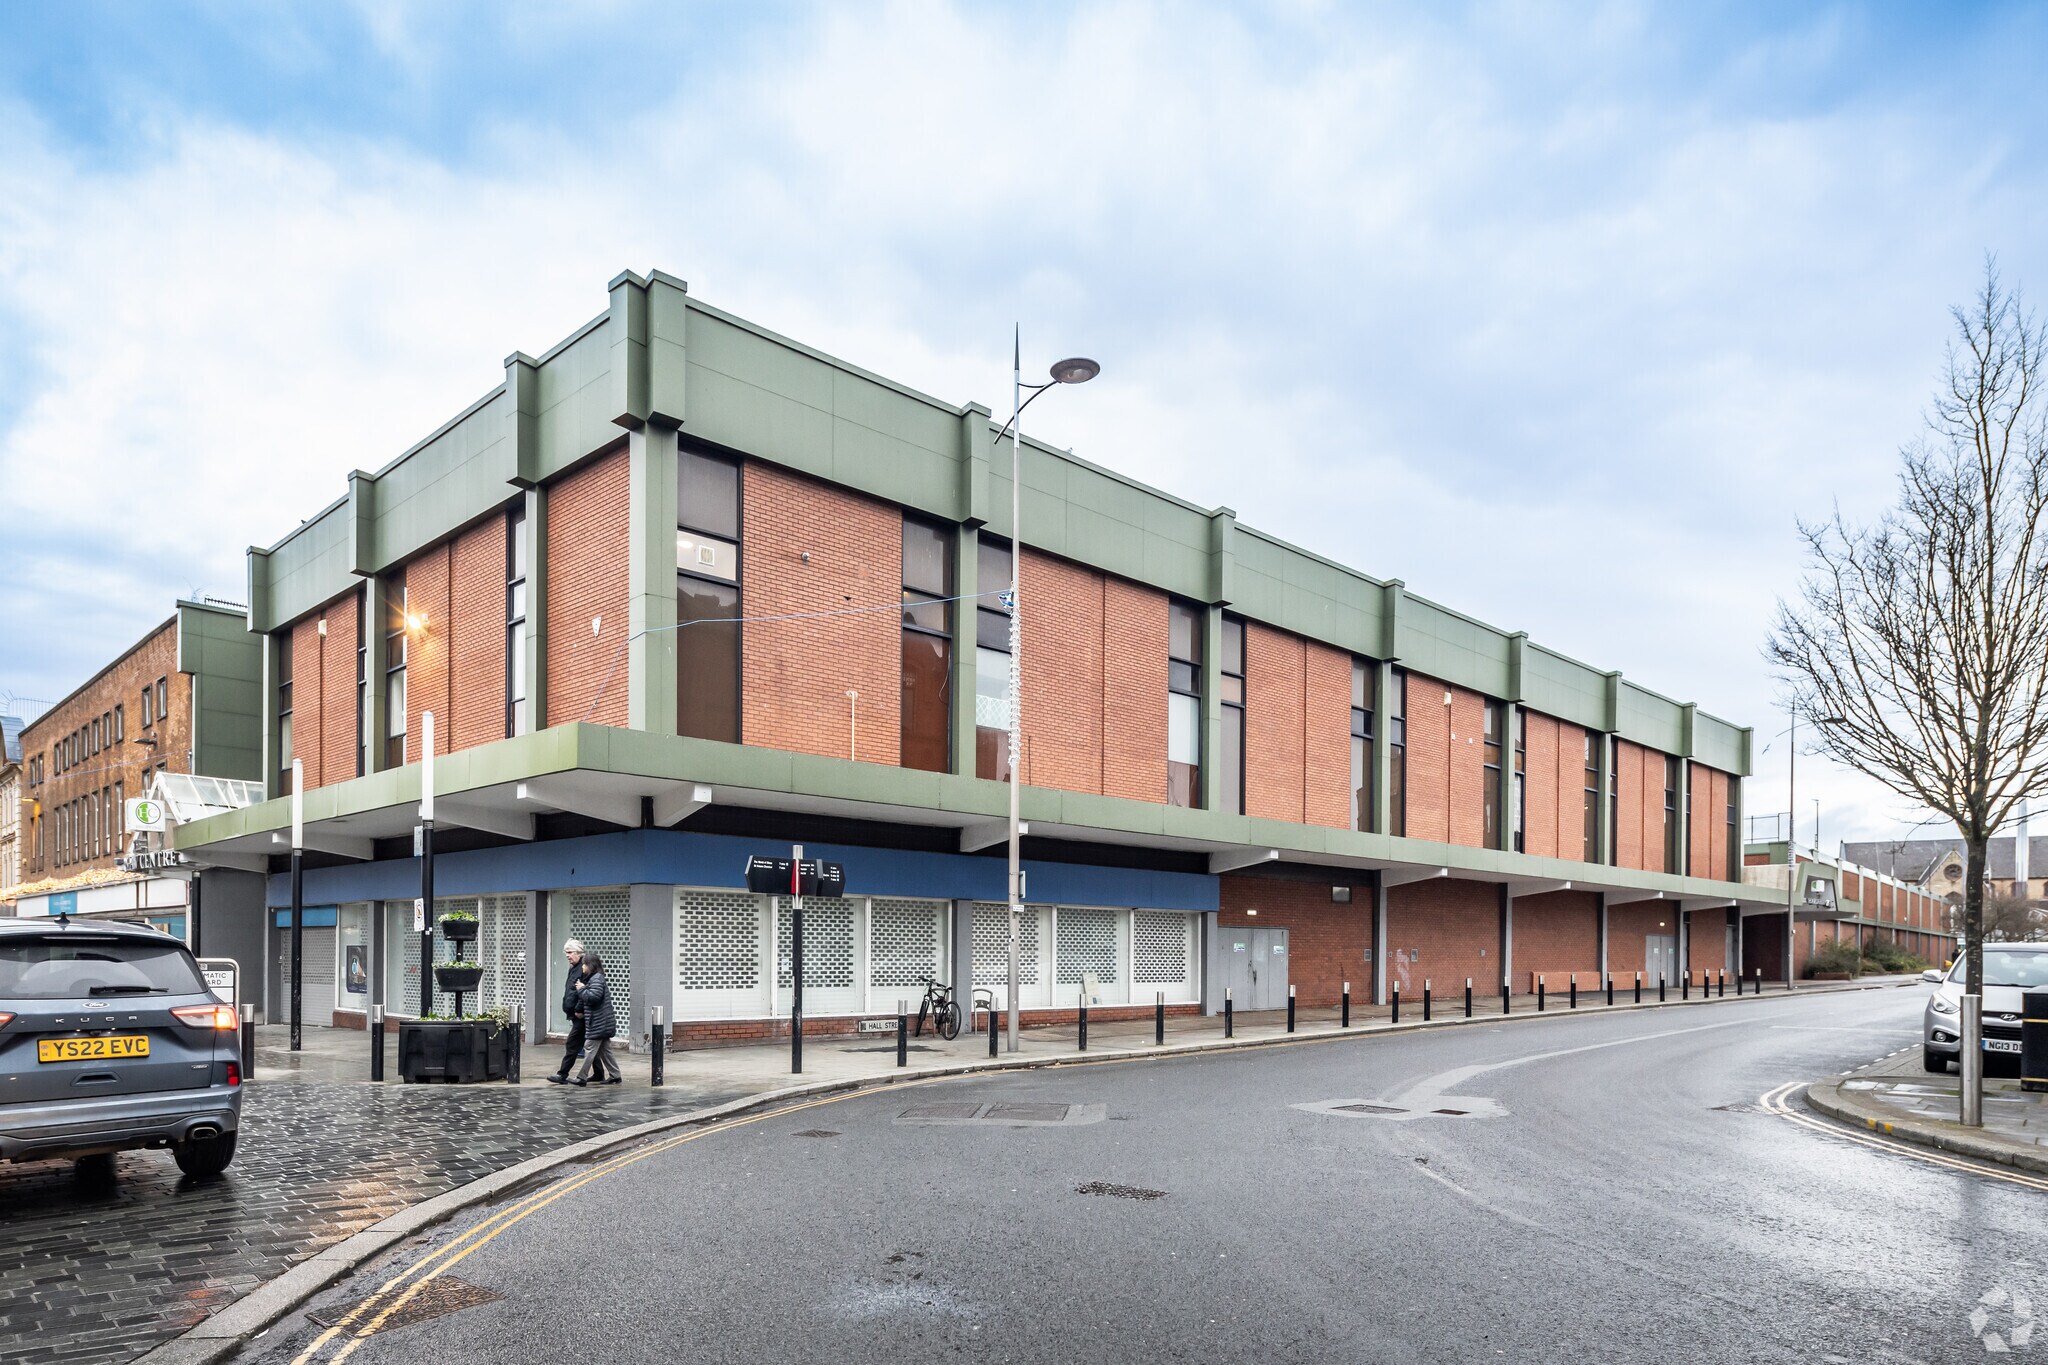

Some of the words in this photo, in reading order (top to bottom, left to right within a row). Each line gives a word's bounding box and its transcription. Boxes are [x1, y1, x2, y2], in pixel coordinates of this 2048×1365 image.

[140, 851, 177, 869] CENTRE
[55, 1016, 138, 1024] KUGA
[868, 1022, 883, 1030] HALL
[884, 1021, 898, 1029] STRE
[53, 1041, 105, 1058] YS22
[110, 1038, 147, 1054] EVC
[1988, 1041, 2010, 1051] NG13
